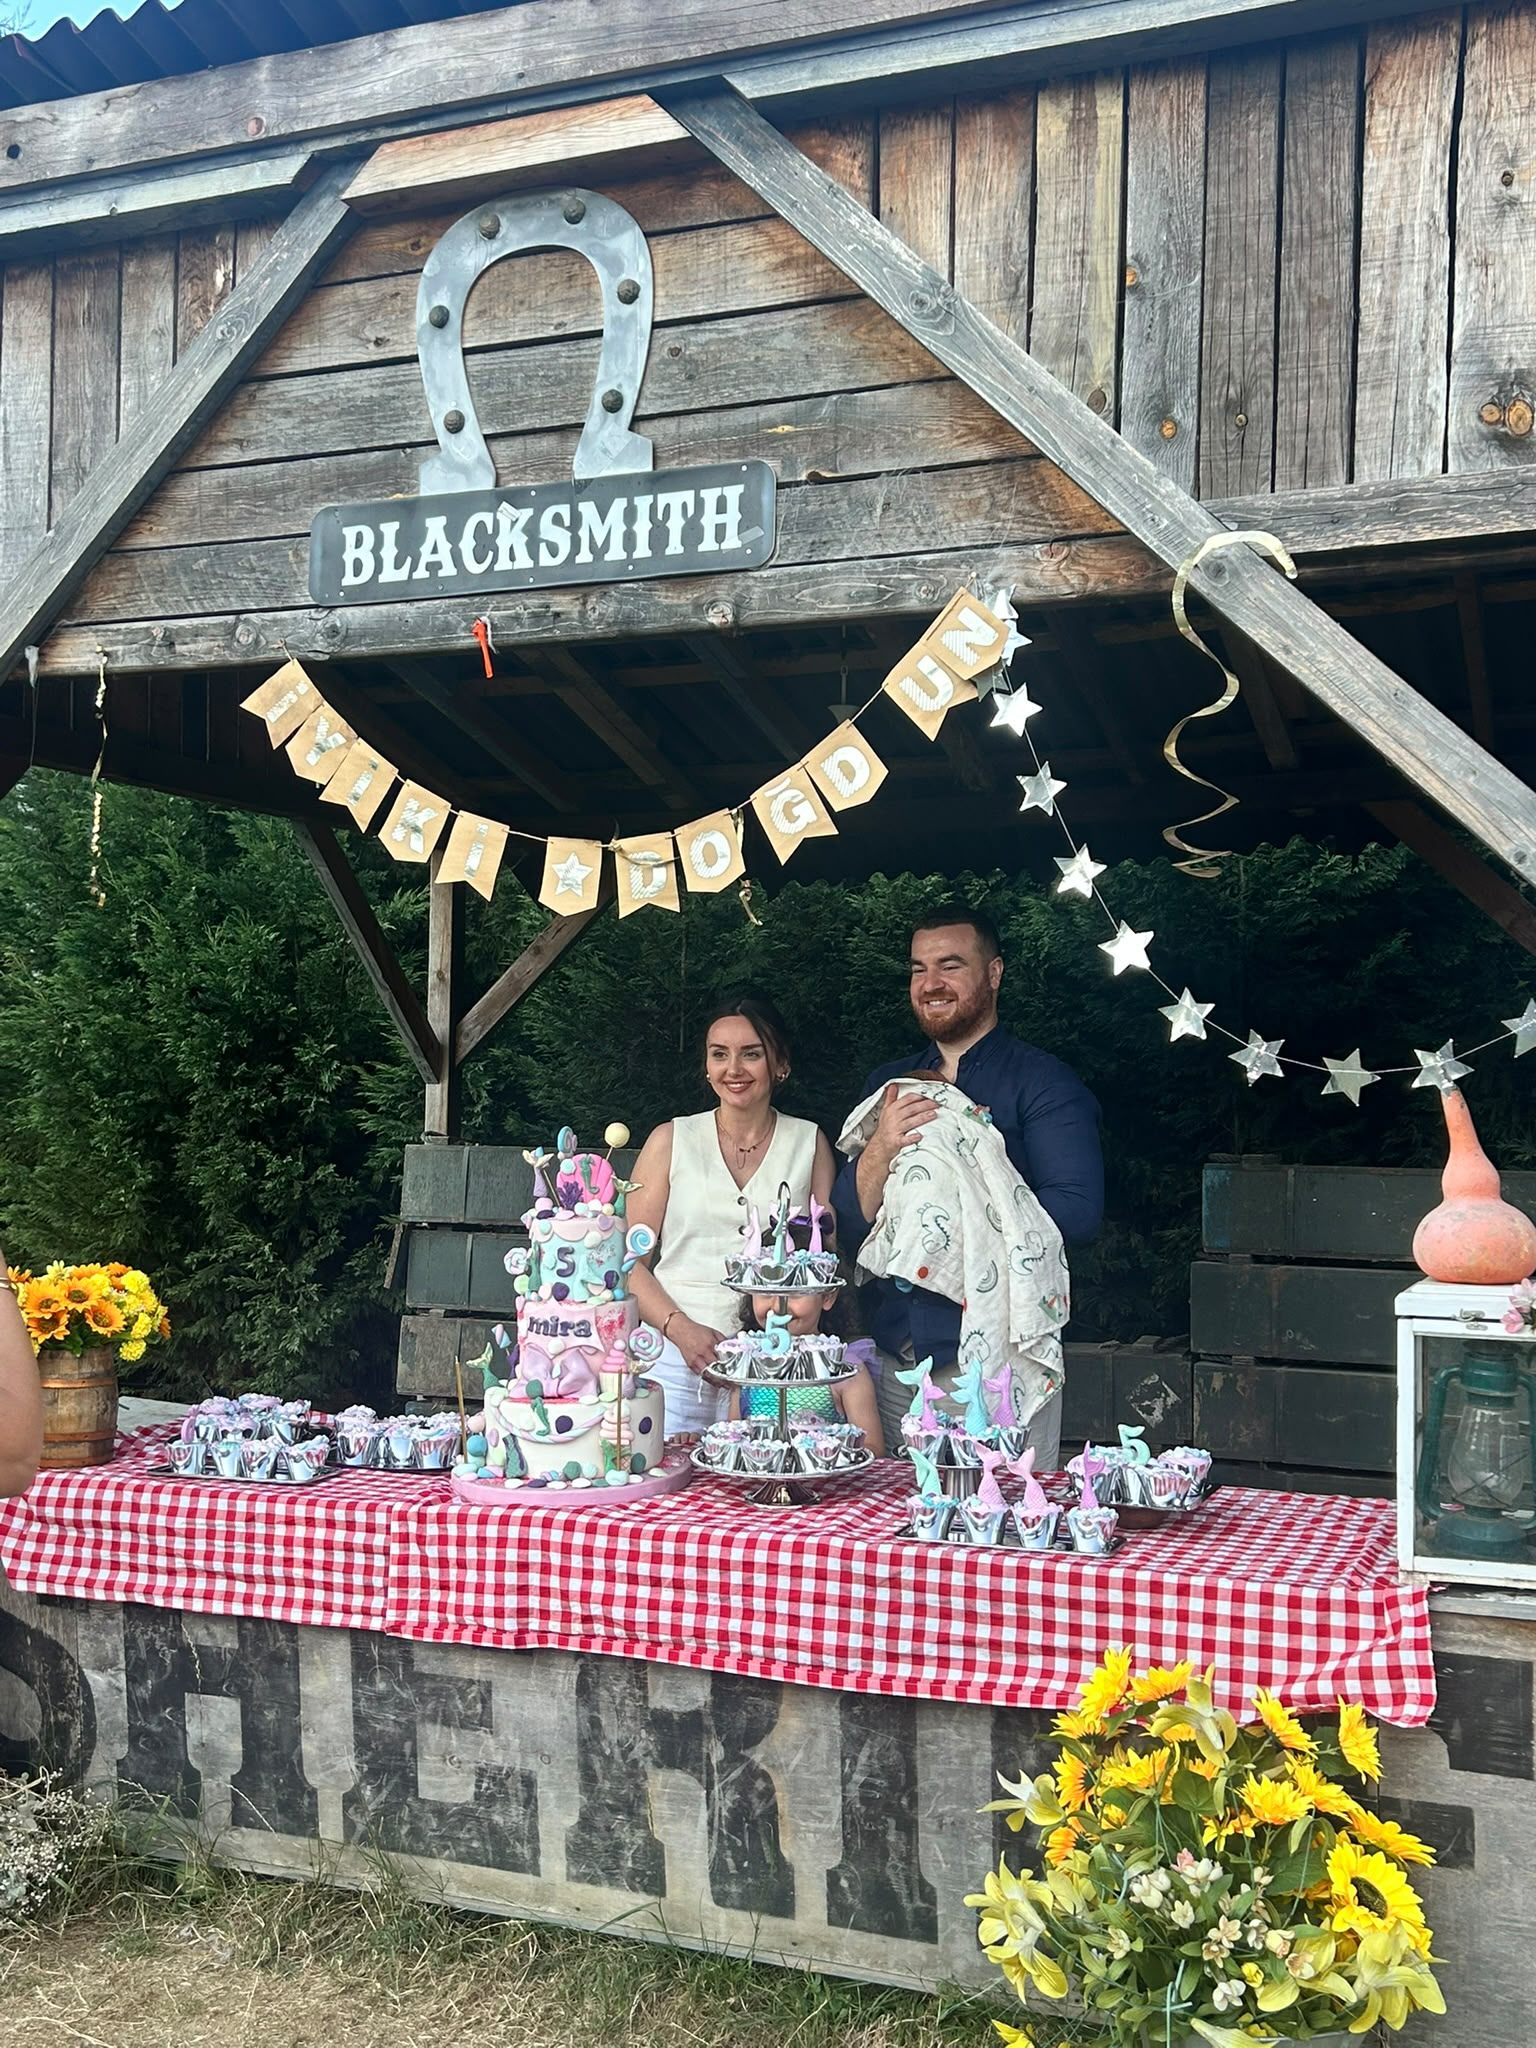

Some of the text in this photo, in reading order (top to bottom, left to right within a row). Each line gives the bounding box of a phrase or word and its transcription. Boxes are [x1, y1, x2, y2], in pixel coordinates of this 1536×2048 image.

[341, 485, 745, 587] BLACKSMITH
[556, 1246, 577, 1278] 5
[527, 1314, 593, 1338] mira
[761, 1310, 793, 1353] 5
[1117, 1424, 1151, 1465] 5
